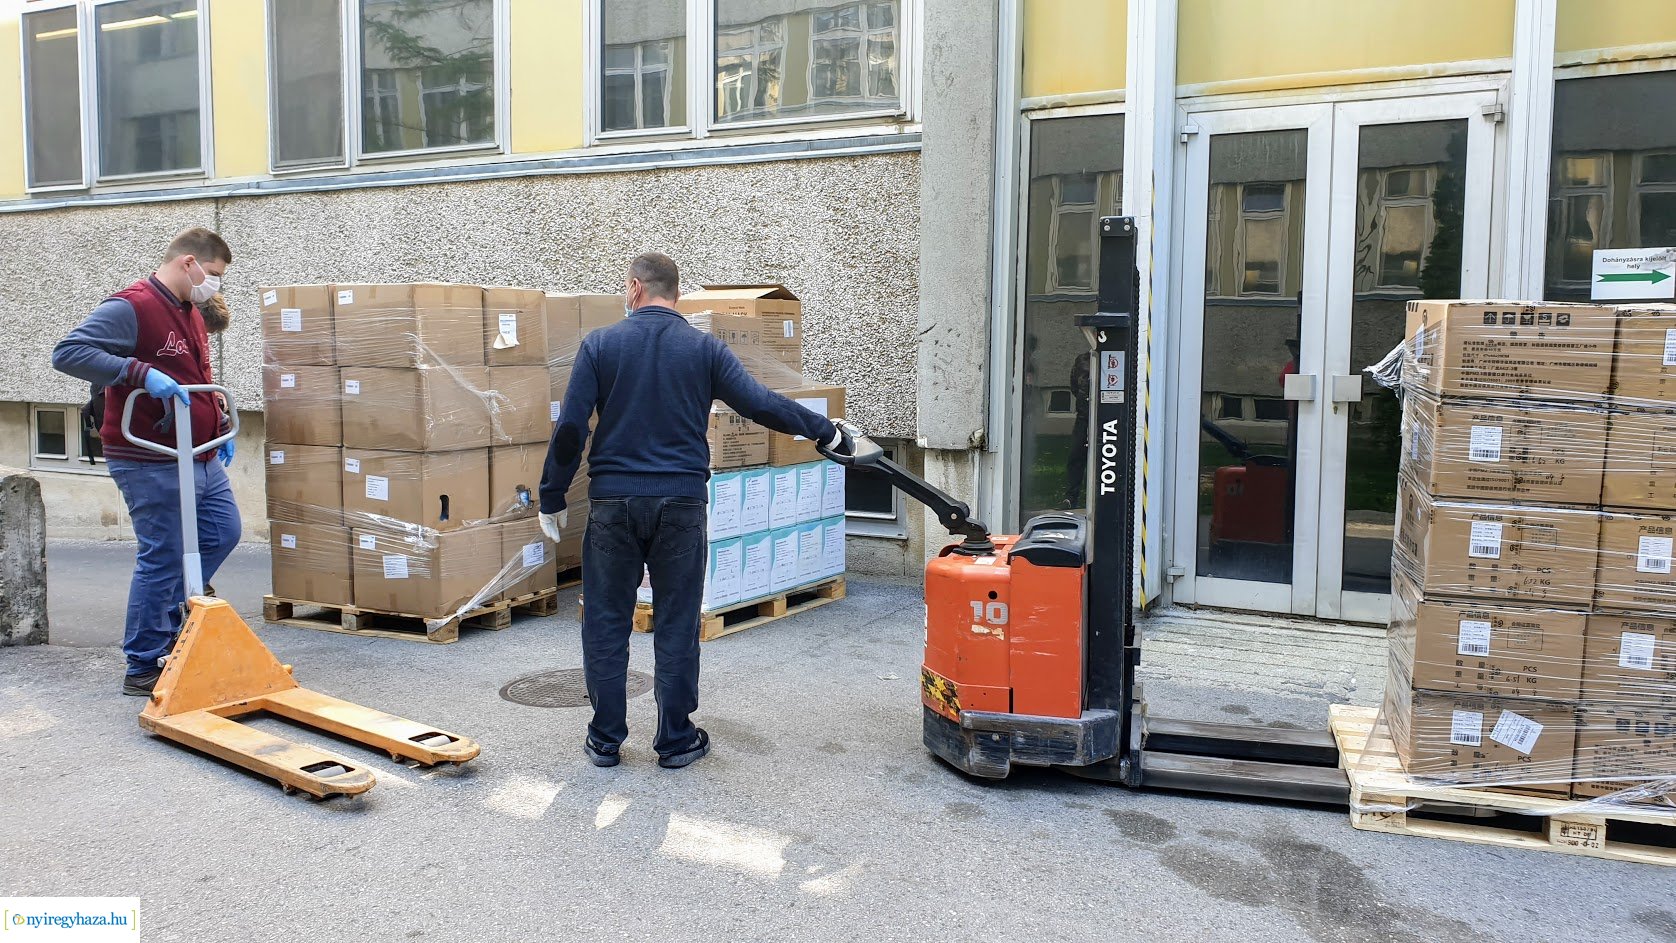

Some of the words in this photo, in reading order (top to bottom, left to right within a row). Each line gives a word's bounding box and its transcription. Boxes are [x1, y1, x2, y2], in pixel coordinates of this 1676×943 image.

[1602, 256, 1643, 264] Dohányzásra
[1100, 419, 1118, 496] TOYOTA
[1639, 525, 1673, 535] 产品信息
[970, 601, 1008, 624] 10
[1621, 621, 1655, 631] 产品信息
[1523, 665, 1538, 673] PCS
[1517, 755, 1532, 763] PCS
